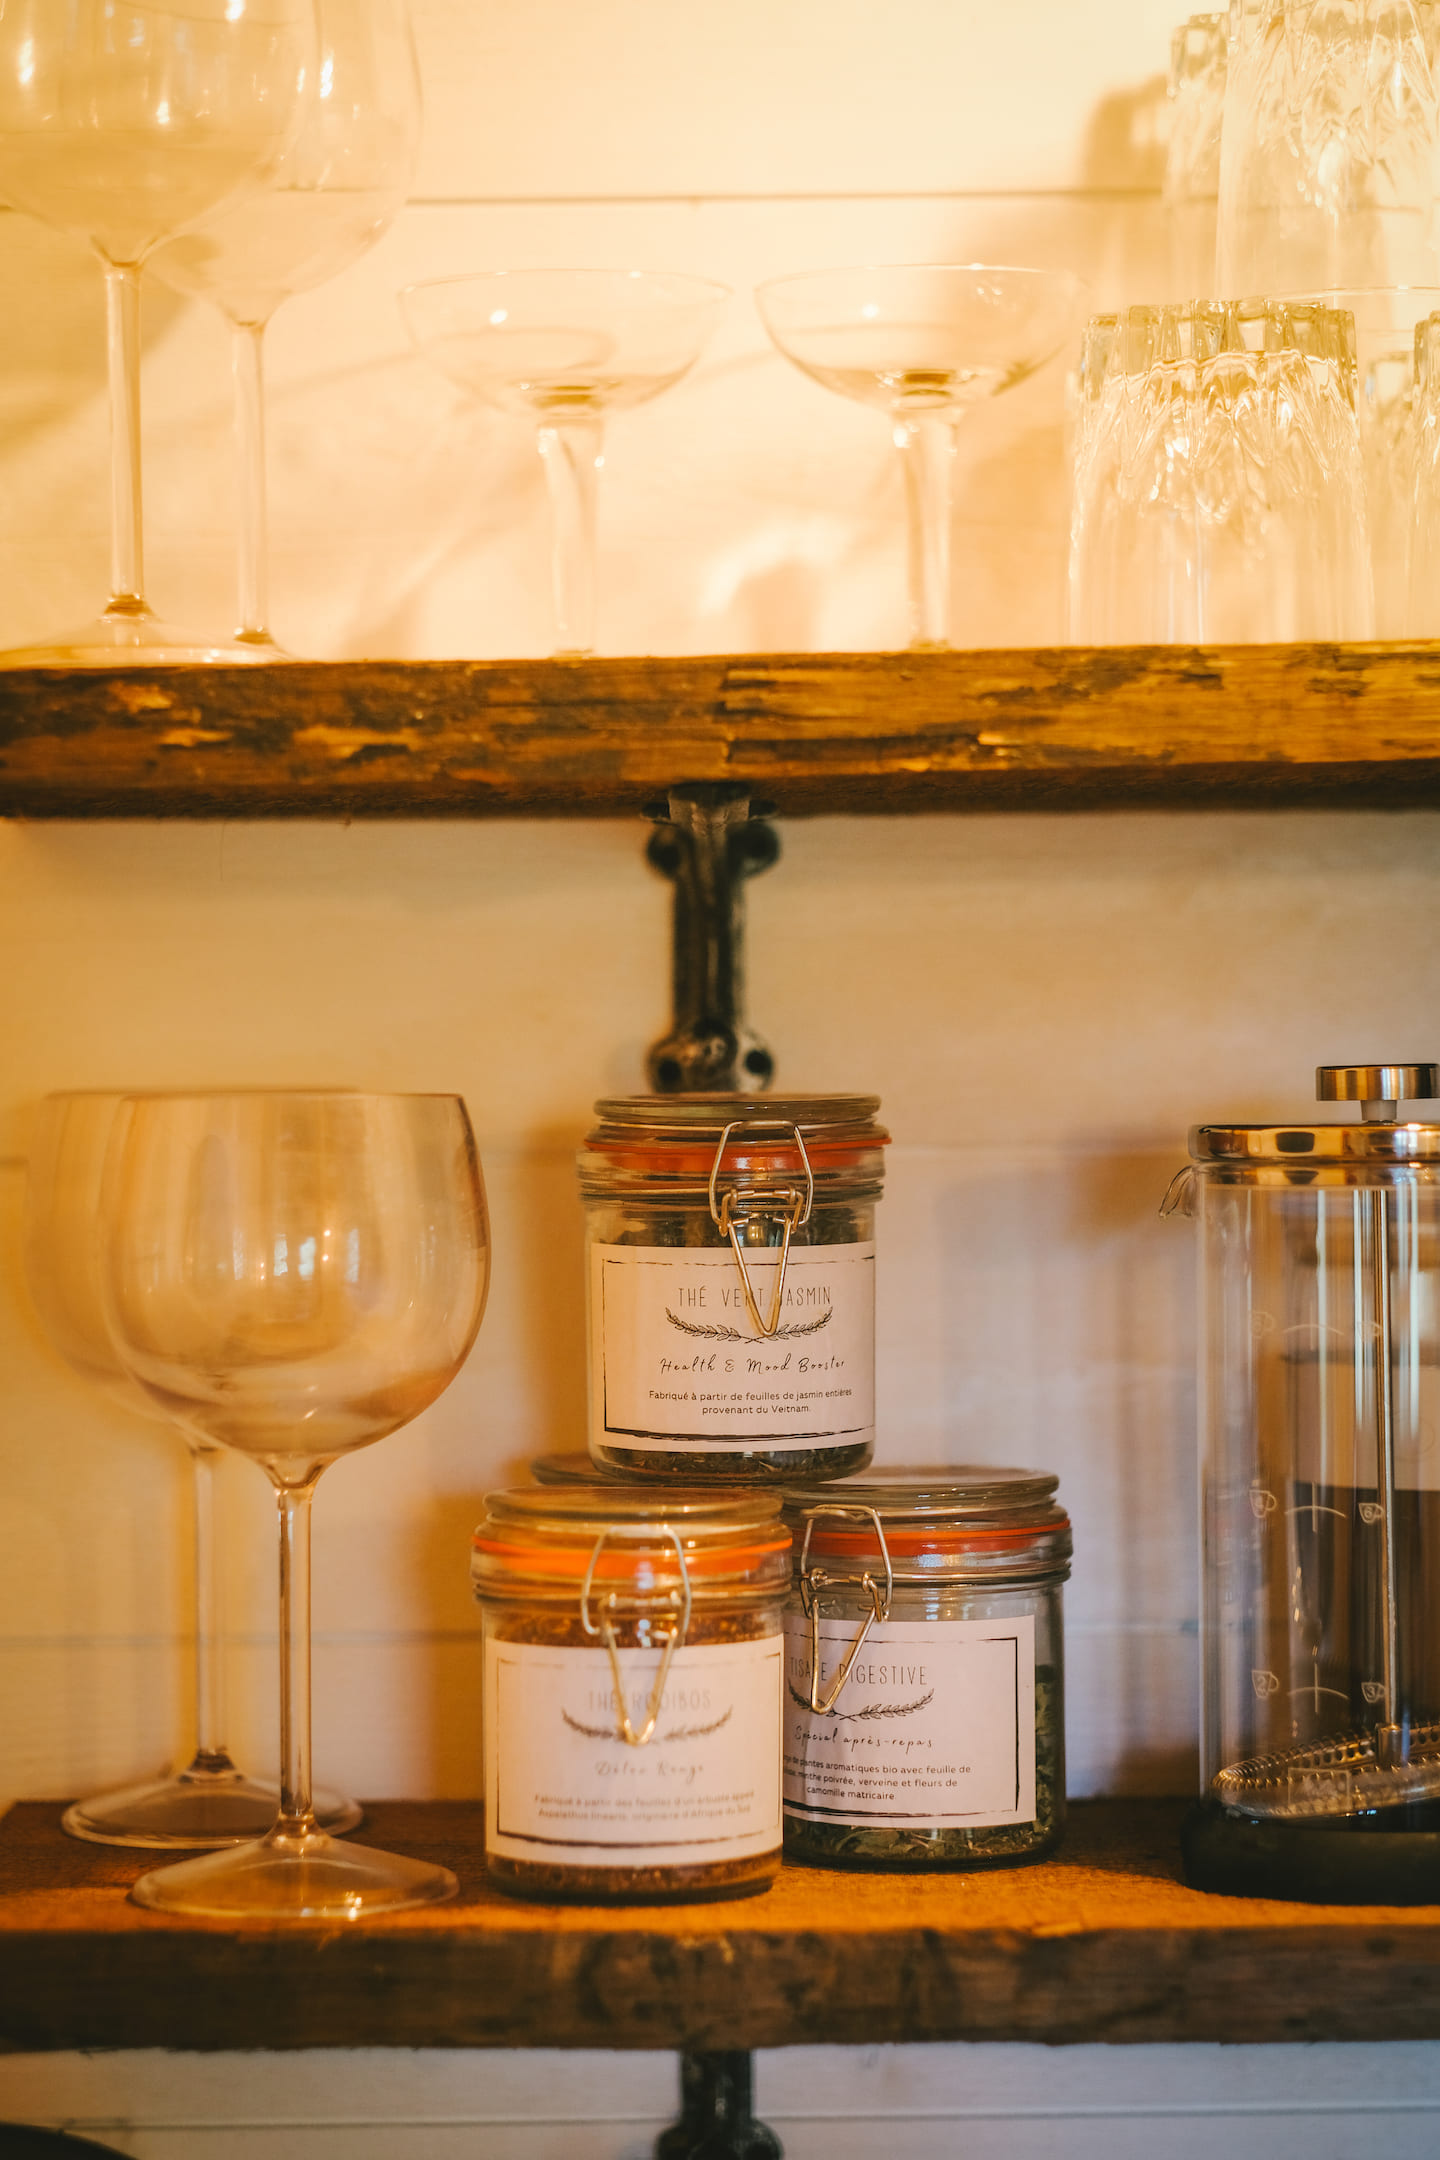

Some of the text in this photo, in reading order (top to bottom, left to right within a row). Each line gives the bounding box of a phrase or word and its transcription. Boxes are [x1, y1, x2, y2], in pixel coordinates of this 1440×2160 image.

[678, 1285, 707, 1308] THÉ
[777, 1286, 832, 1307] ASMIN
[659, 1353, 845, 1375] Health & Mood Booster
[649, 1390, 689, 1402] Fabriqué
[691, 1391, 697, 1401] à
[700, 1391, 727, 1403] partir
[730, 1391, 743, 1401] de
[745, 1391, 780, 1401] feuilles
[782, 1391, 794, 1400] de
[795, 1390, 823, 1402] jasmin
[702, 1406, 753, 1416] provenant
[756, 1404, 769, 1414] du
[790, 1656, 828, 1682] TISAE
[842, 1735, 933, 1755] après-repas
[825, 1761, 880, 1775] aromatiques
[882, 1764, 898, 1774] bio
[900, 1767, 923, 1775] avec
[926, 1765, 956, 1774] feuille
[959, 1765, 971, 1774] de
[858, 1777, 899, 1788] verveine
[901, 1778, 911, 1787] et
[914, 1778, 943, 1788] fleurs
[945, 1778, 958, 1788] de
[806, 1785, 846, 1798] camomille
